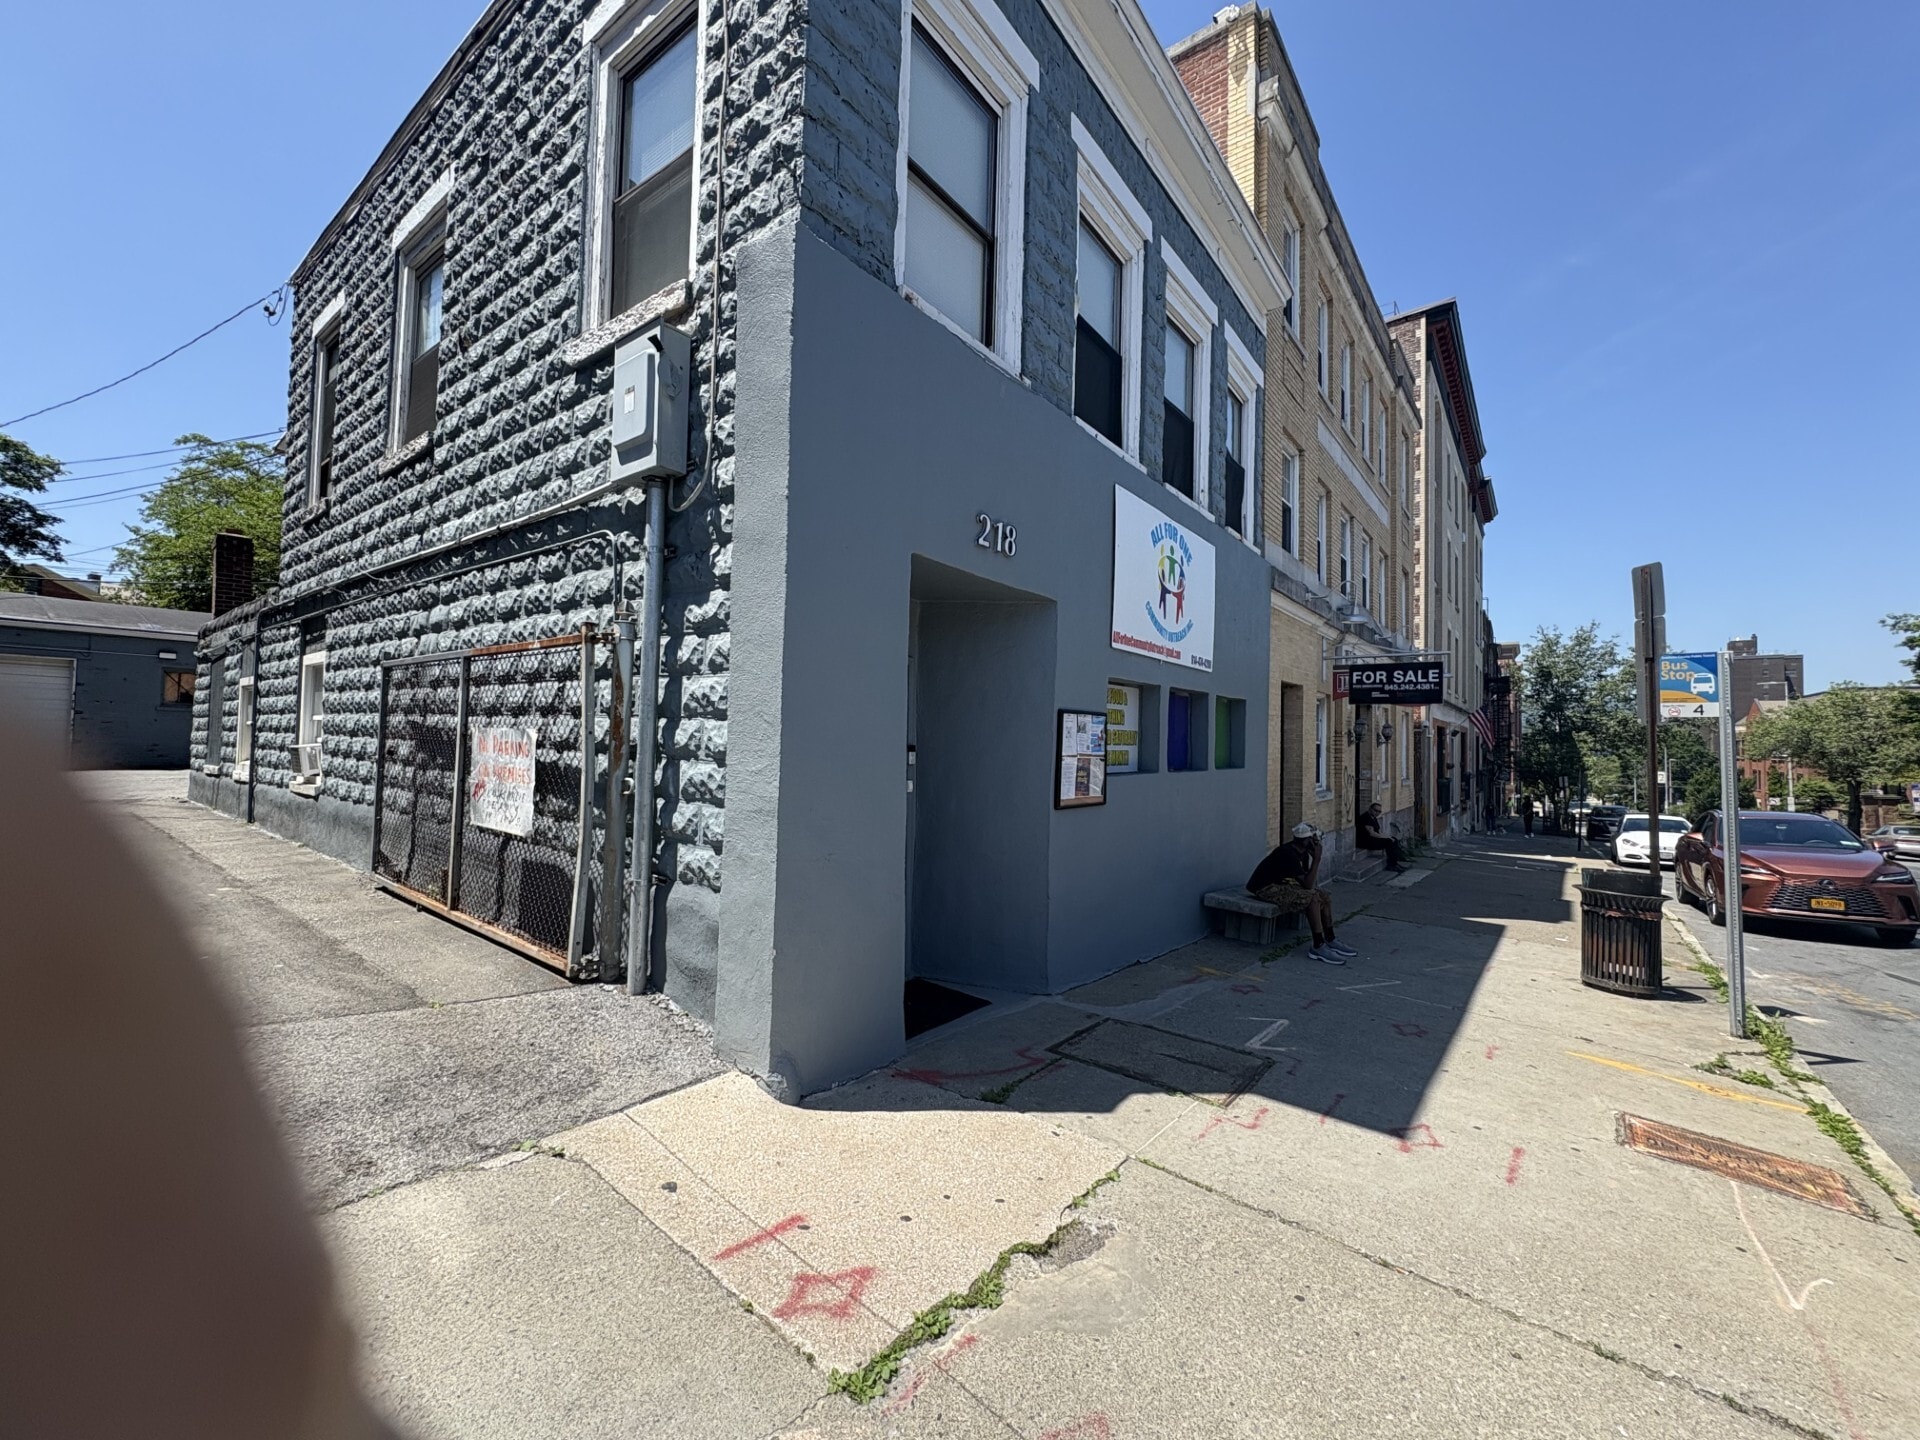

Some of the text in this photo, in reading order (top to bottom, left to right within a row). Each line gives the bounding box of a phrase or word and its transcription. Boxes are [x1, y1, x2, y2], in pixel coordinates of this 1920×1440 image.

[976, 513, 1016, 557] 218
[1150, 522, 1193, 567] ALL FOR ONE
[1145, 601, 1168, 640] COMMUNITY
[1168, 627, 1187, 643] OUTREACH
[1661, 661, 1688, 670] Bus
[1352, 669, 1440, 684] FOR SALE
[1661, 670, 1695, 682] Stop
[1693, 704, 1704, 716] 4
[493, 735, 530, 758] PARKING
[493, 764, 531, 784] PREMISES
